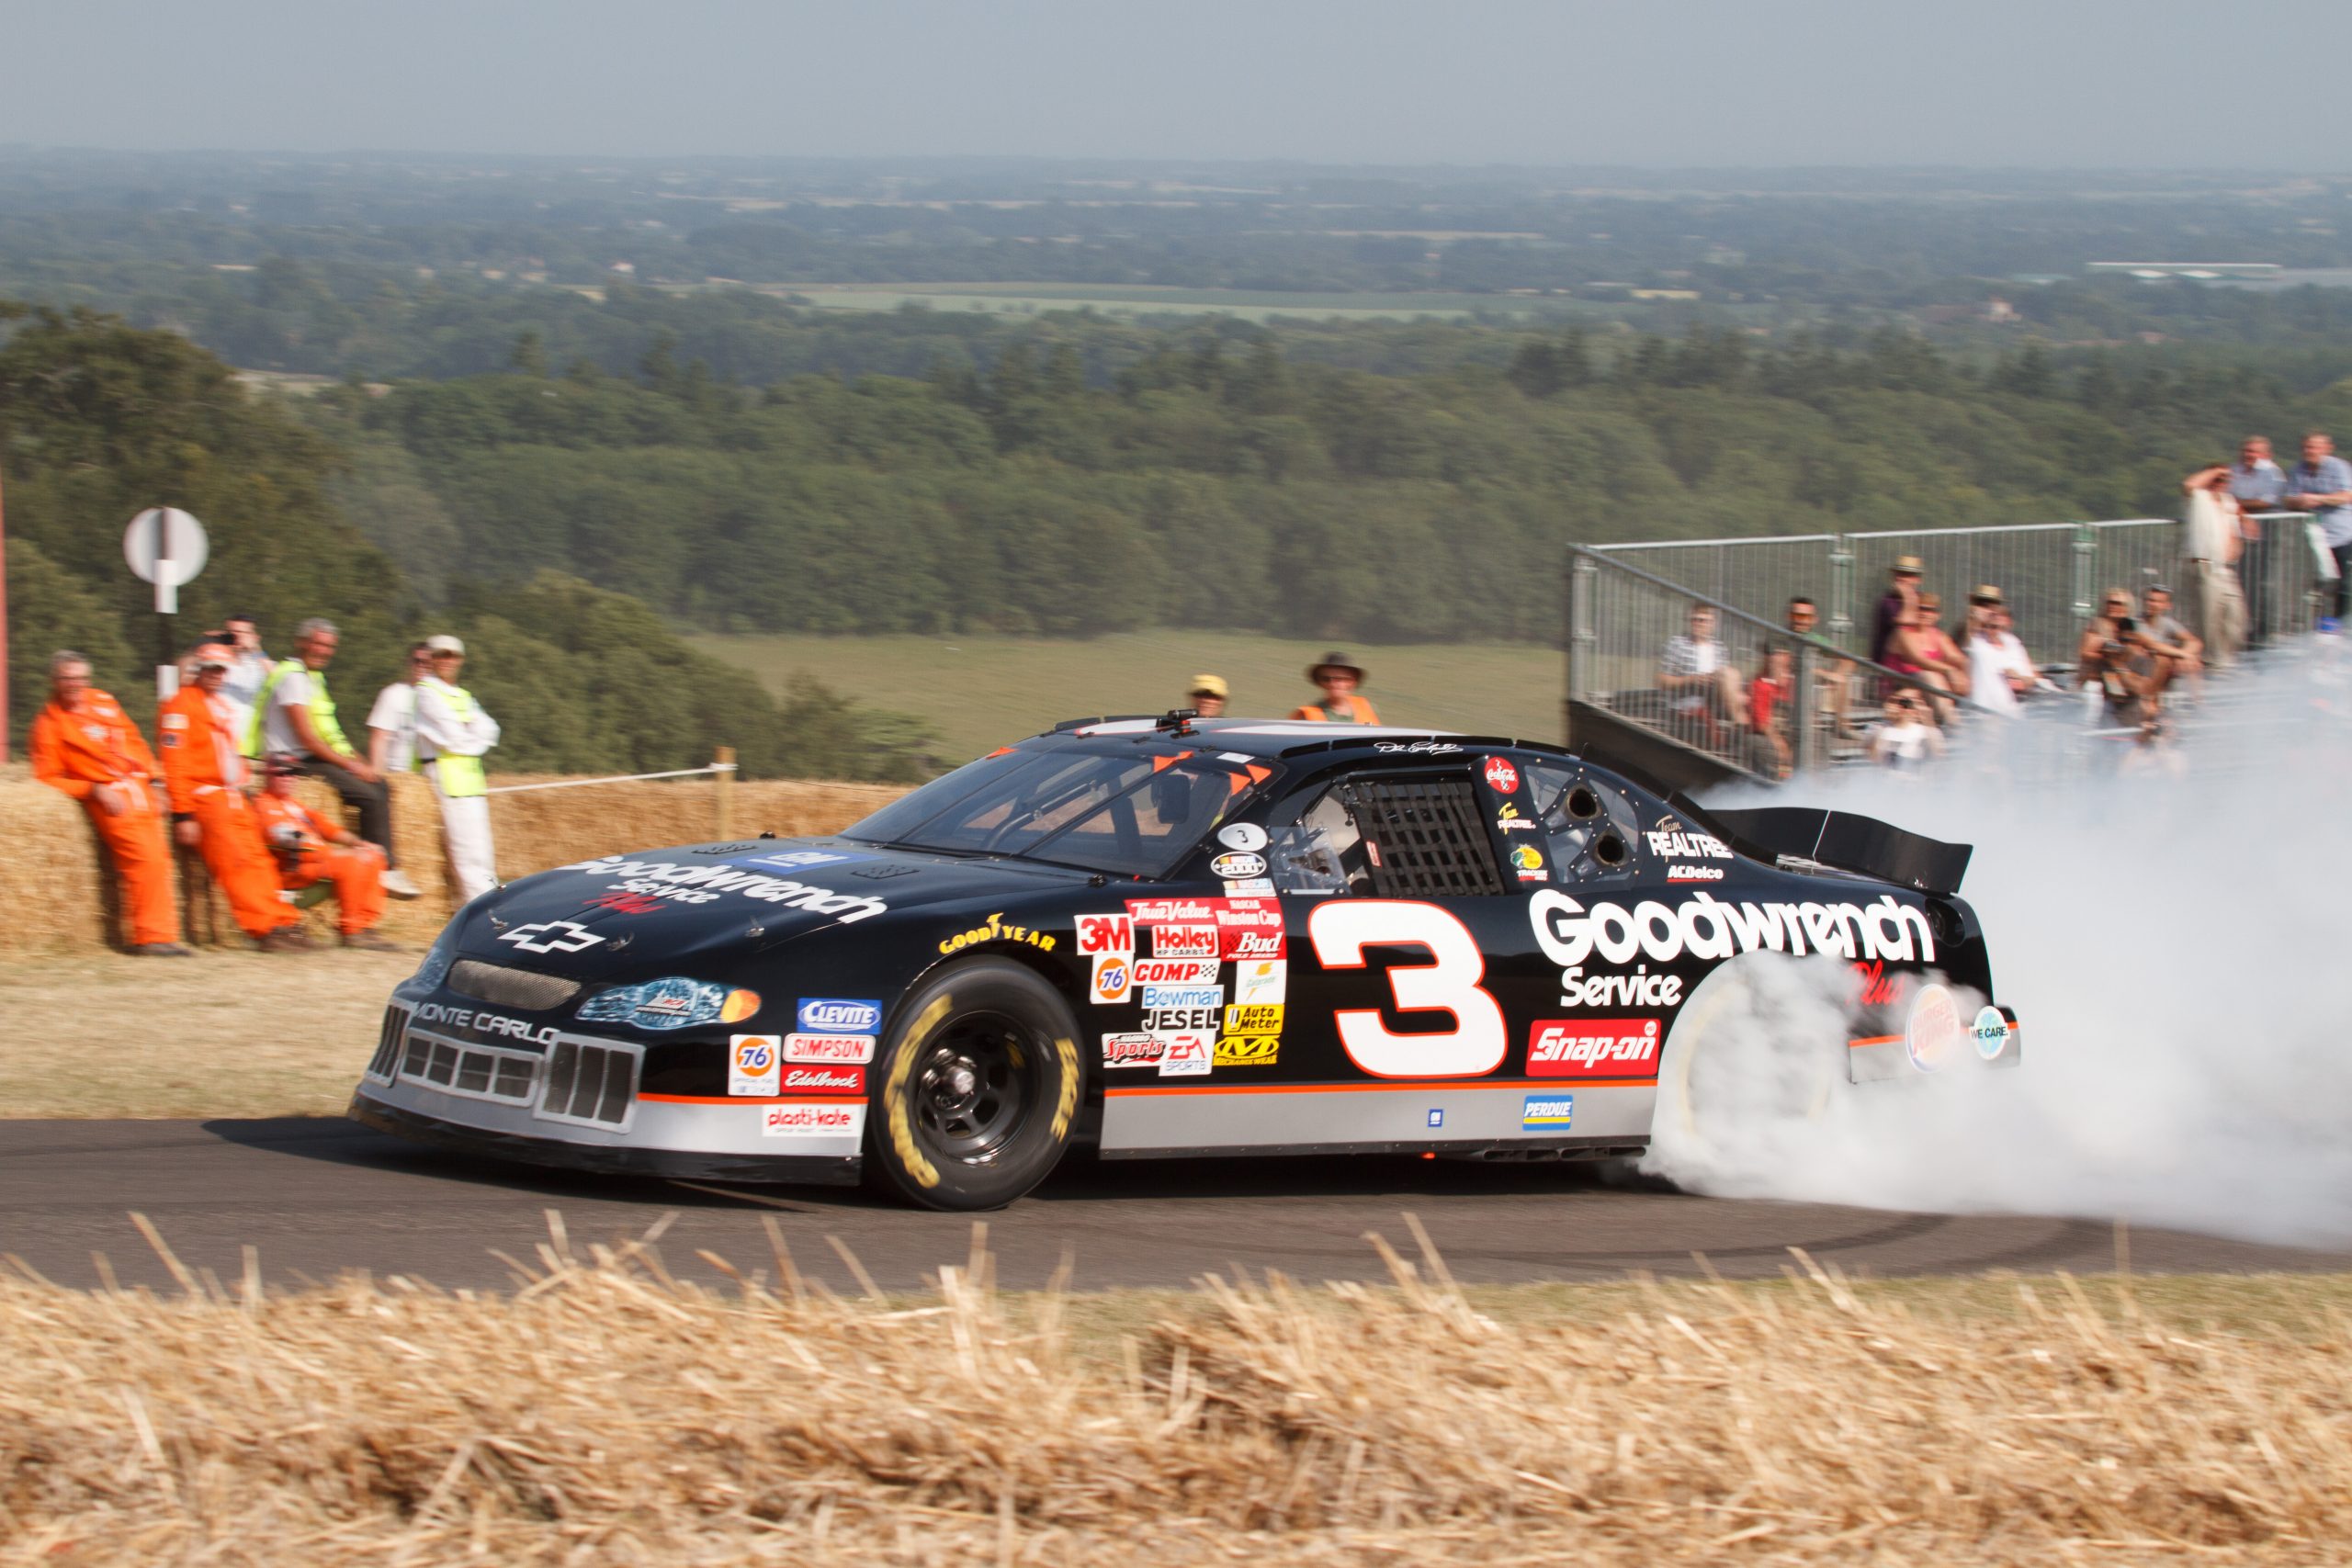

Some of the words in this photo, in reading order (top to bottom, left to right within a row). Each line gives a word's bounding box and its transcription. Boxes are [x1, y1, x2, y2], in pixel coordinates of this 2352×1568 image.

[1237, 829, 1249, 843] 3
[1646, 831, 1734, 858] REALTREE
[1220, 863, 1259, 875] 2000
[556, 855, 888, 924] Goodwrench
[606, 878, 720, 904] Service
[1215, 910, 1258, 927] Winston
[1259, 909, 1282, 928] Cup
[1529, 889, 1936, 965] Goodwrench
[1080, 917, 1132, 953] 3M
[1156, 926, 1216, 954] Holley
[1236, 931, 1283, 953] Bud
[1102, 968, 1124, 989] 76
[1135, 963, 1200, 982] COMP
[1307, 898, 1508, 1078] 3
[1560, 964, 1683, 1008] Service
[1145, 987, 1221, 1007] Bowman
[803, 1000, 876, 1024] CLEVITE
[1144, 1010, 1218, 1031] JESEL
[1243, 1007, 1274, 1019] Auto
[1240, 1018, 1281, 1030] Meter
[1971, 1028, 1984, 1040] WE
[740, 1046, 769, 1067] 76
[792, 1038, 866, 1057] SIMPSON
[1104, 1039, 1166, 1064] Sports
[1168, 1035, 1206, 1060] EA
[1530, 1027, 1657, 1068] Snap-on
[1166, 1061, 1205, 1071] SPORTS
[785, 1069, 859, 1089] Edelbrock
[767, 1108, 852, 1127] plasti-kote
[1524, 1101, 1572, 1117] PERDUE
